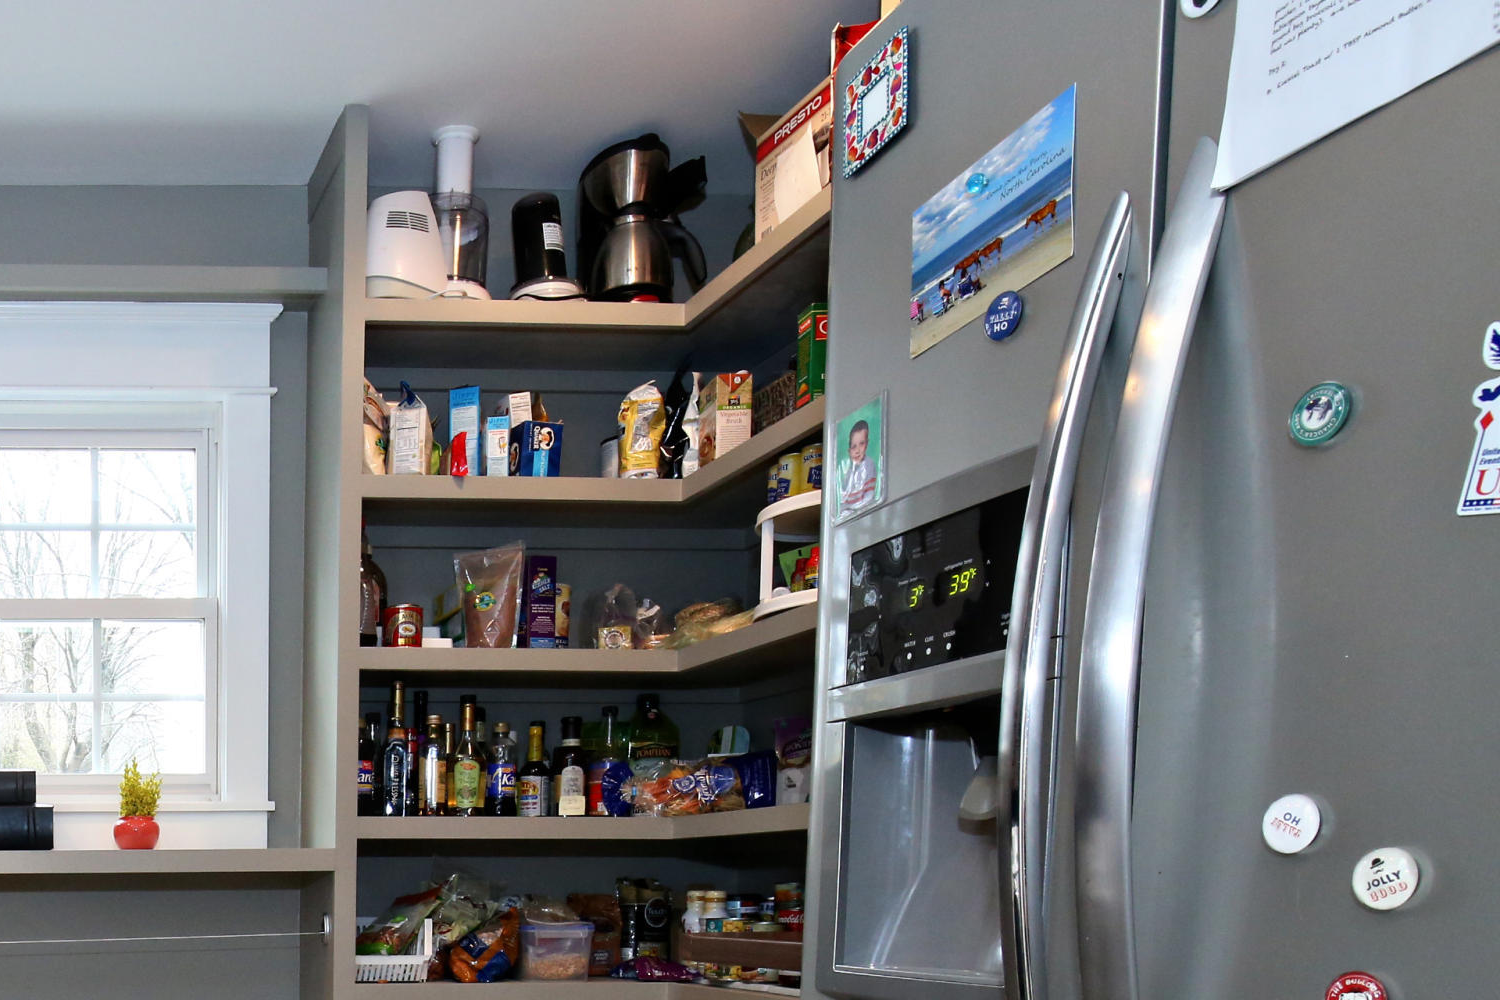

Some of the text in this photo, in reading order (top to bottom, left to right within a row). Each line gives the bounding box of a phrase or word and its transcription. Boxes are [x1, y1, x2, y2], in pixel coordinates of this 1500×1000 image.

[774, 95, 822, 145] PRESTO
[1000, 147, 1066, 201] North Carolina
[994, 321, 1008, 333] HO
[720, 411, 749, 419] Vegetable
[358, 773, 373, 784] aro
[1283, 811, 1301, 826] OH
[1366, 870, 1401, 891] JOLLY
[1331, 978, 1381, 998] THE BULLDOG
